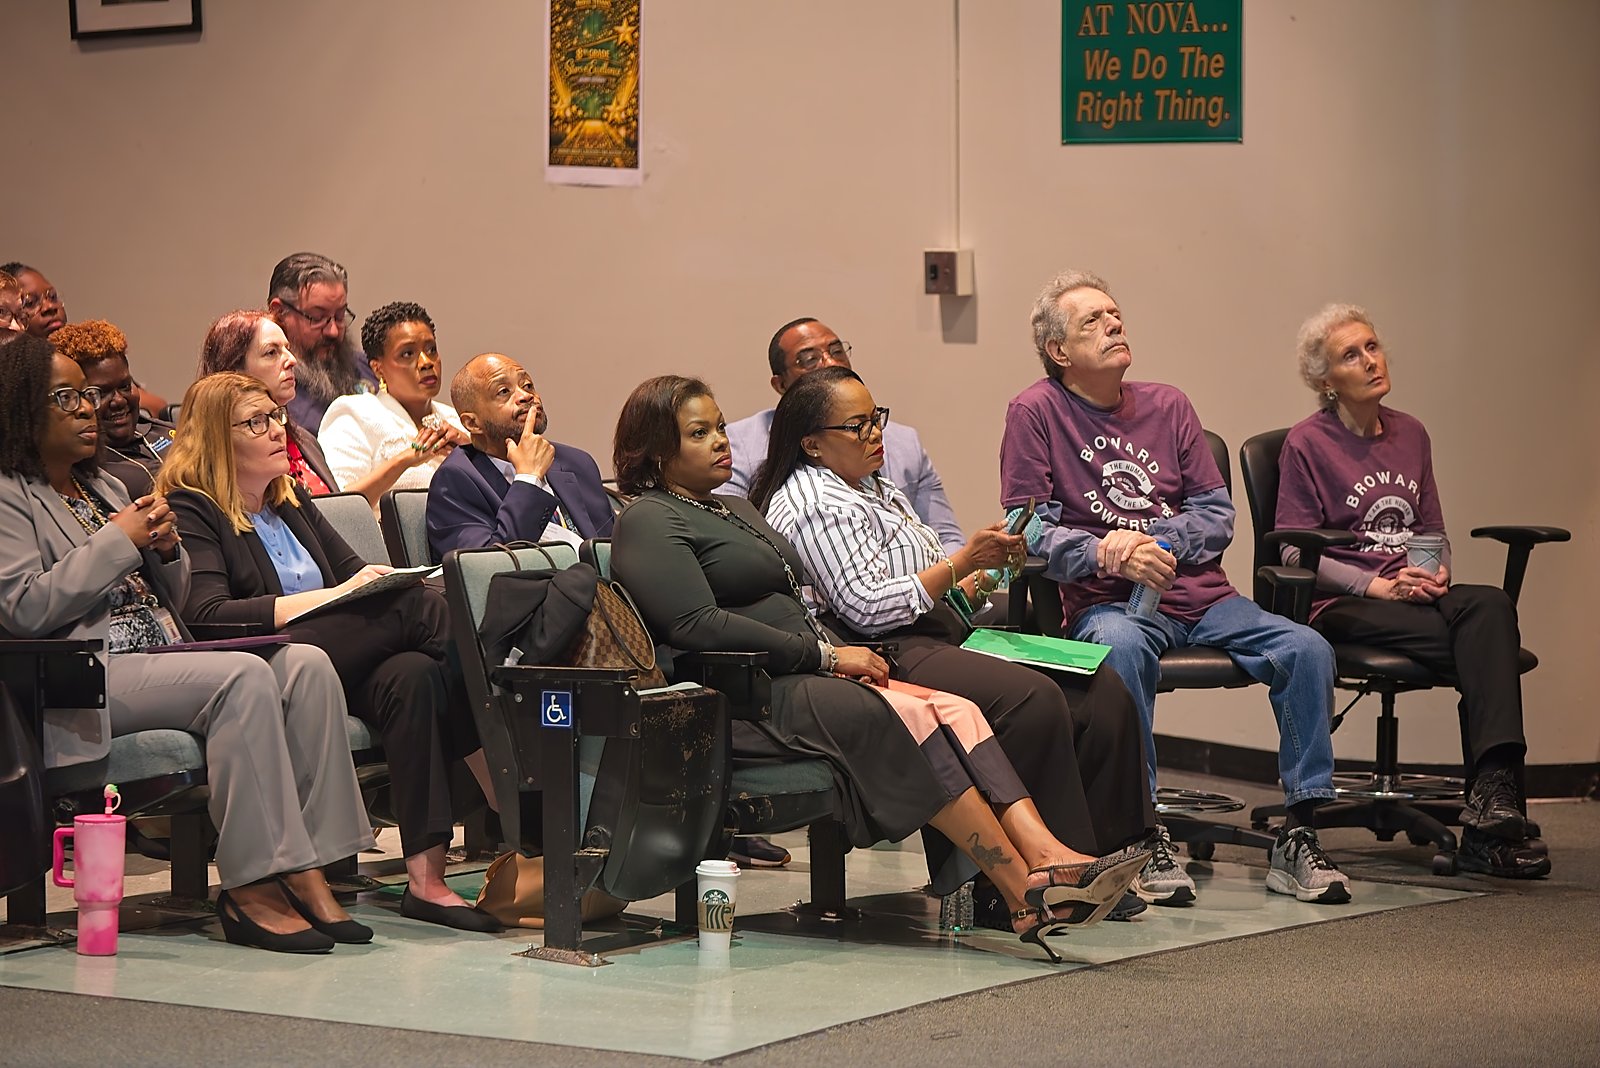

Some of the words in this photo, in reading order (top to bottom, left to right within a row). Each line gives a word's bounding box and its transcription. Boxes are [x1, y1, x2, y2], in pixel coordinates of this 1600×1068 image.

[1077, 4, 1114, 36] AT
[1127, 2, 1229, 35] NOVA...
[1084, 48, 1122, 81] We
[1131, 47, 1168, 81] Do
[1178, 45, 1226, 79] The
[1076, 90, 1145, 130] Right
[1154, 88, 1231, 128] Thing.
[1080, 436, 1159, 482] BOWARD
[1109, 462, 1122, 471] THE
[1125, 464, 1147, 482] HUMAN
[1114, 494, 1122, 503] IN
[1124, 499, 1137, 508] THE
[1345, 471, 1420, 509] BROWAR
